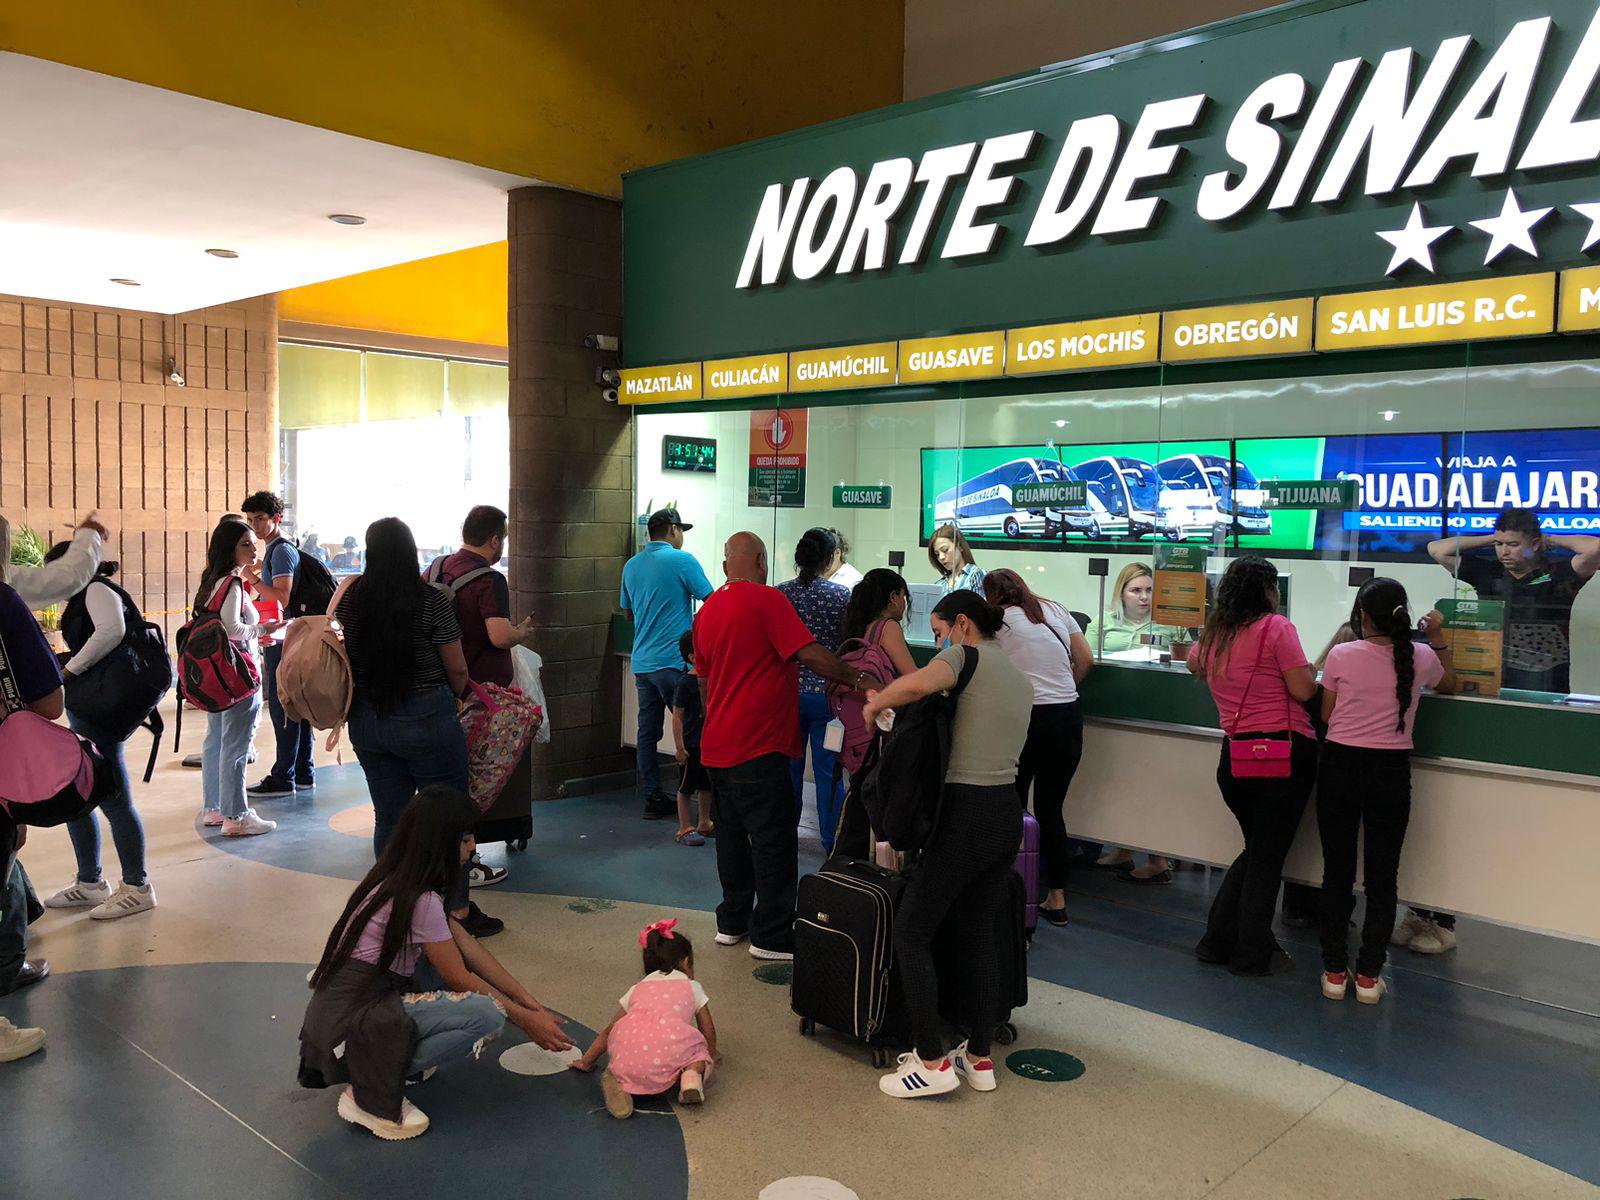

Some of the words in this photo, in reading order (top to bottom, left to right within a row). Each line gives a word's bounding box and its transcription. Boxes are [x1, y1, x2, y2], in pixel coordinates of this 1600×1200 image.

[735, 130, 1037, 289] NORTE
[1023, 93, 1208, 247] DE
[1331, 307, 1394, 335] SAN
[1398, 301, 1466, 330] LUIS
[1474, 294, 1536, 323] R.C.
[1174, 312, 1299, 348] OBREGÓN
[1016, 339, 1056, 361] LOS
[1060, 329, 1146, 358] MOCHIS
[797, 355, 889, 381] GUAMÚCHIL
[909, 345, 994, 371] GUASAVE
[626, 371, 693, 395] MAZATLÁN
[711, 363, 780, 388] CULIACÁN
[1435, 455, 1498, 469] VIAJA
[1501, 455, 1517, 468] A
[841, 489, 883, 504] GUASAVE
[1015, 483, 1085, 503] GUAMÚCHIL
[1278, 486, 1341, 504] TIJUANA
[1360, 515, 1467, 528] SALIENDO
